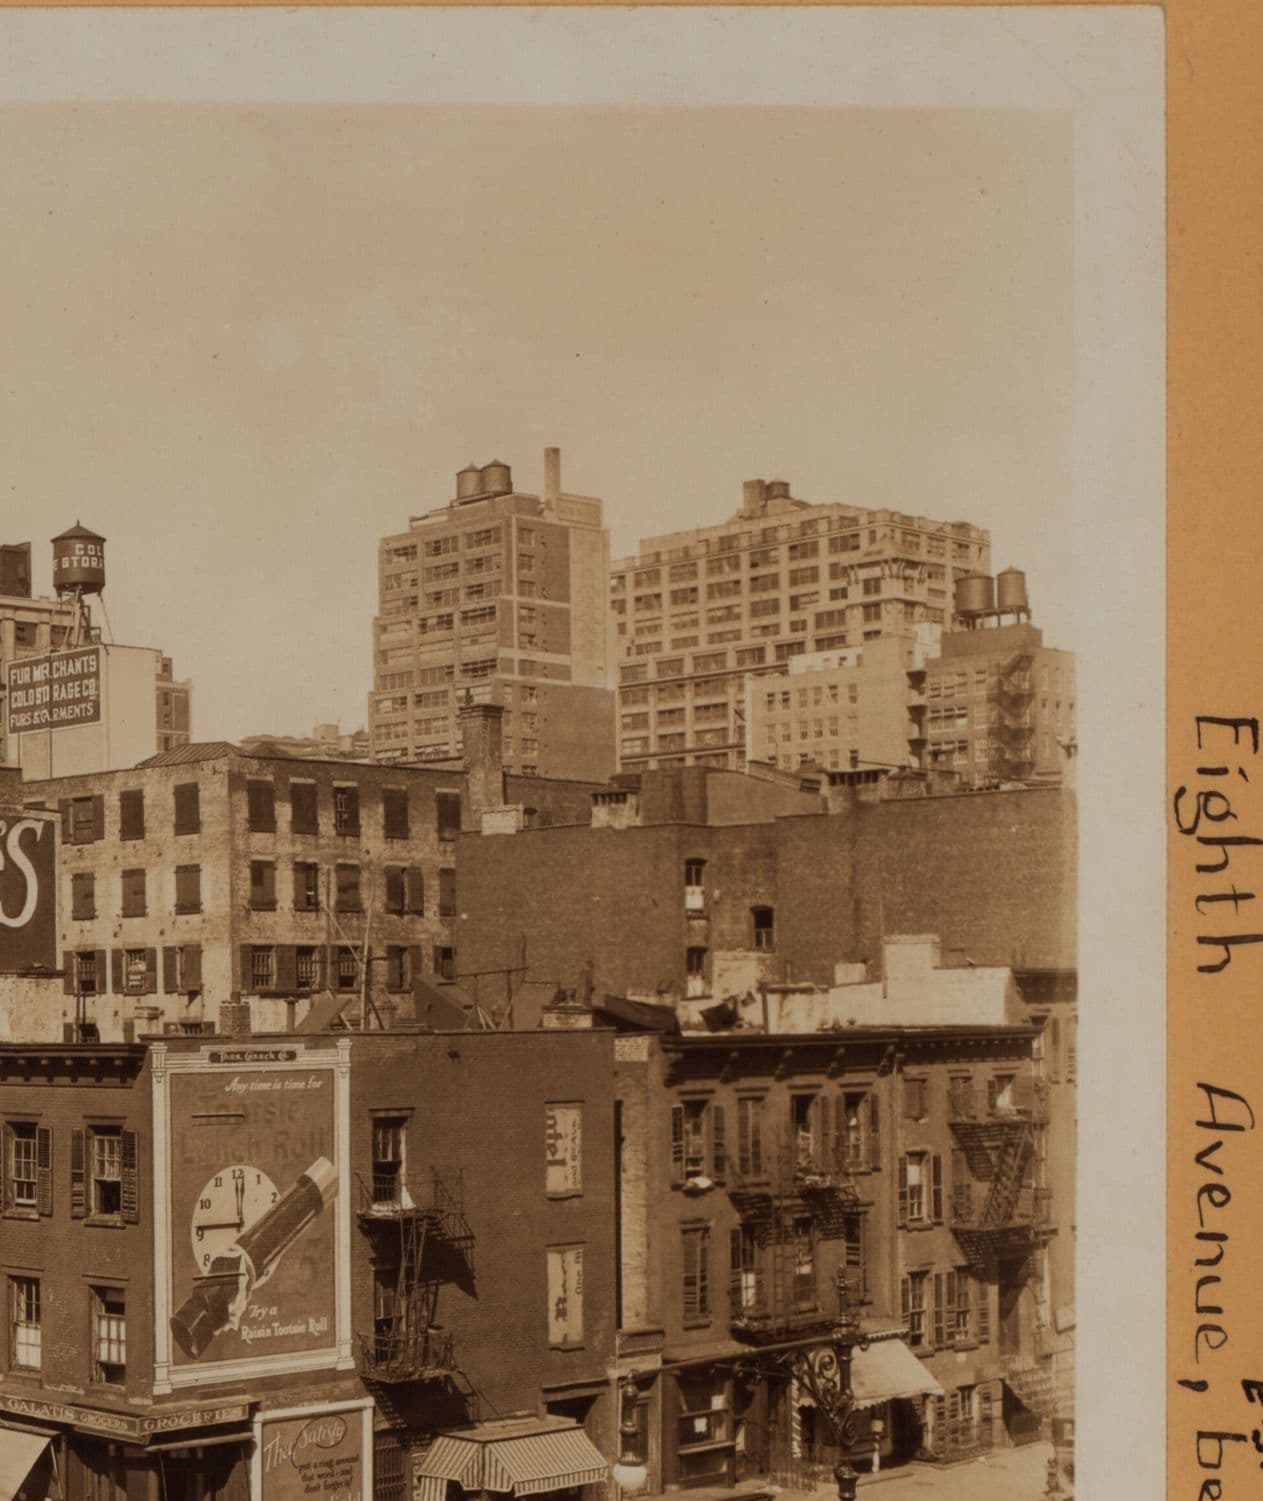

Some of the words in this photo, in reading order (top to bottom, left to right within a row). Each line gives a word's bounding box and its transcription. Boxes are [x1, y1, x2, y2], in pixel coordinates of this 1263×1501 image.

[11, 665, 31, 686] FUR
[11, 688, 34, 708] COLD
[10, 712, 32, 729] FURS
[1175, 714, 1263, 975] Eighth
[250, 1079, 272, 1091] time
[285, 1077, 306, 1089] time
[214, 1177, 223, 1188] 11
[232, 1169, 244, 1180] 12
[199, 1199, 211, 1210] 10
[241, 1324, 272, 1344] Raisin
[272, 1320, 307, 1338] Tootsie
[308, 1316, 328, 1336] Roll
[79, 1412, 129, 1432] GROCERS
